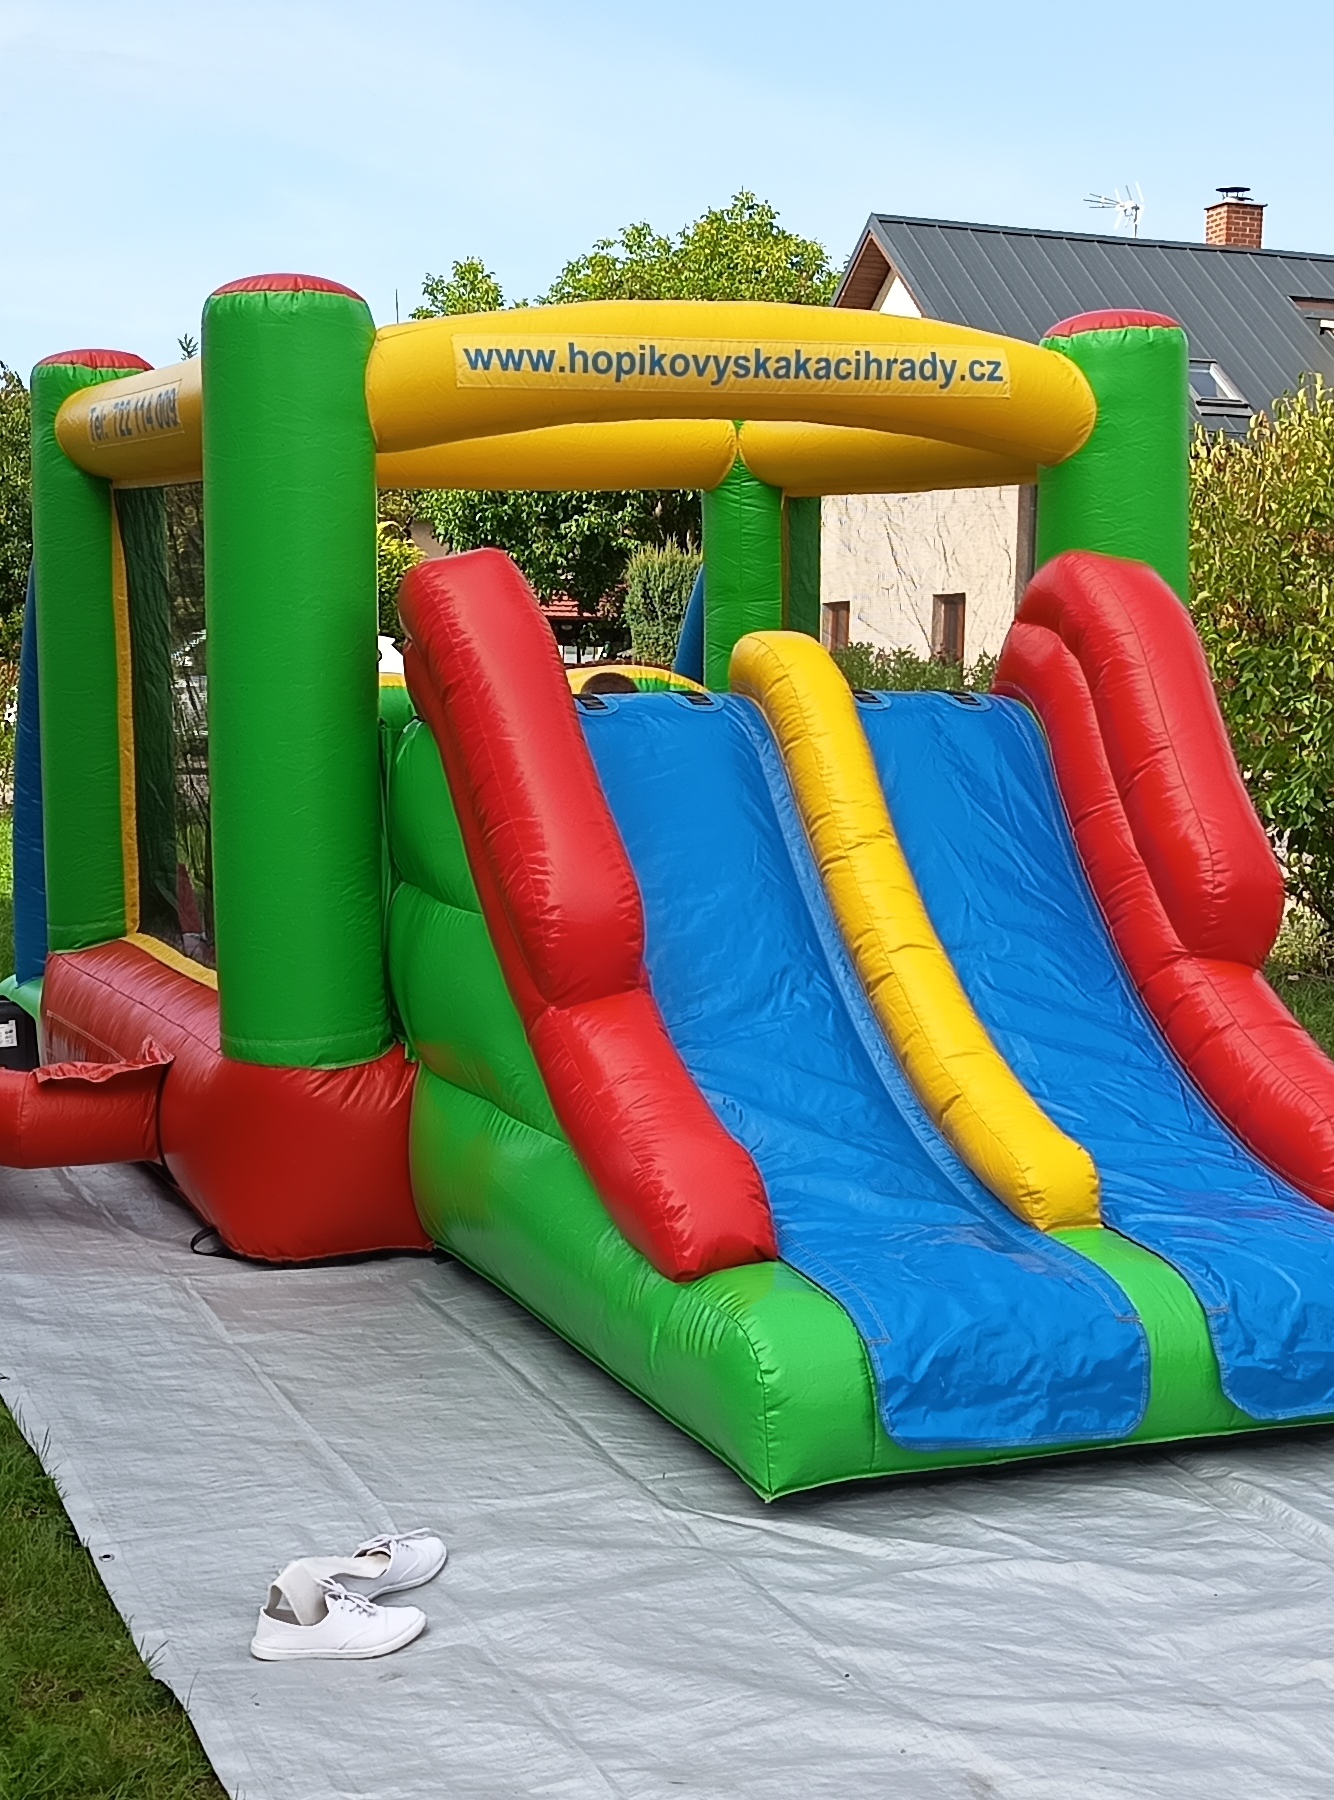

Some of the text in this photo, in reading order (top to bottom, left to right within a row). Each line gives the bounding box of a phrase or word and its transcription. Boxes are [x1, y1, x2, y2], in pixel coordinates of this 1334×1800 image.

[462, 342, 1004, 390] www.hopikovyskakacihrady.cz
[113, 399, 133, 438] 722
[134, 394, 156, 434] 114
[155, 387, 179, 430] 009
